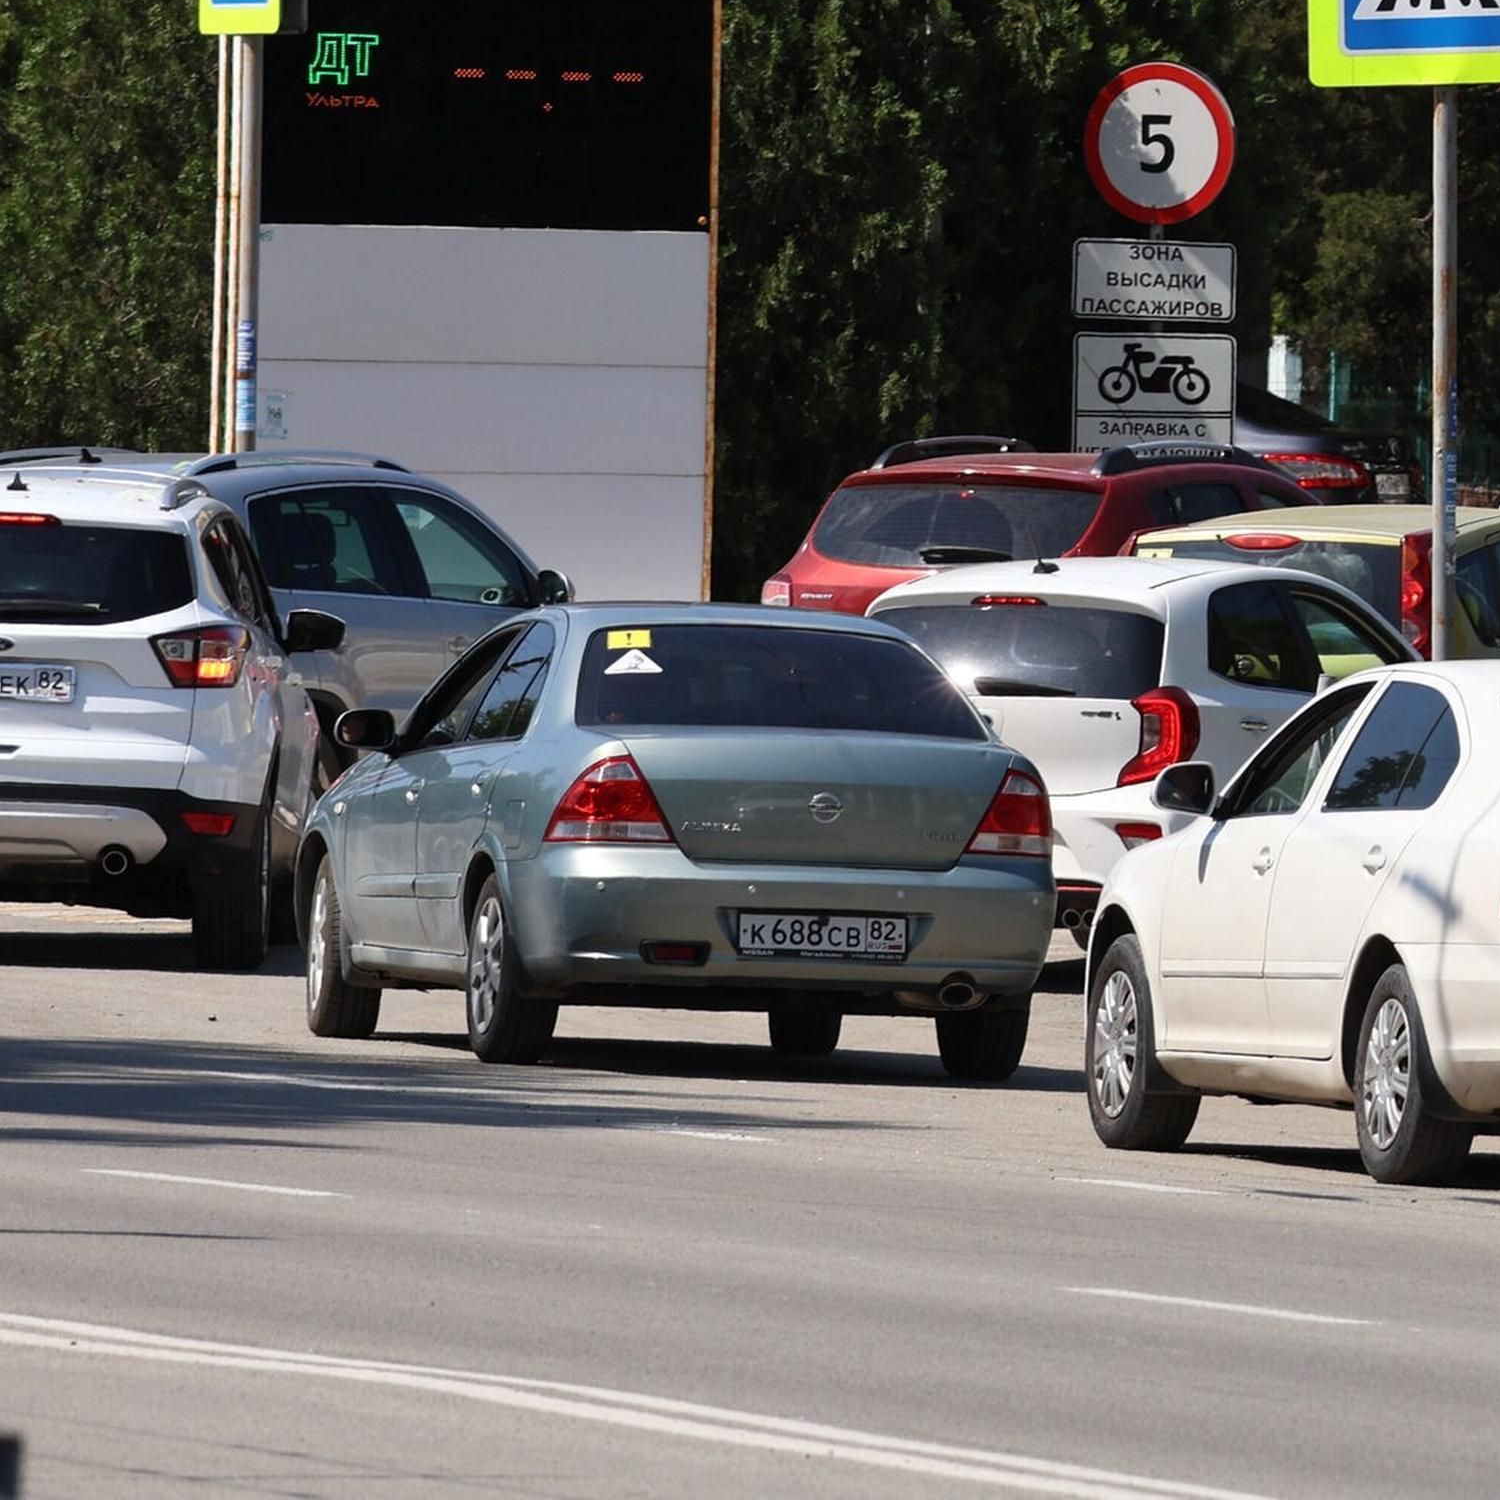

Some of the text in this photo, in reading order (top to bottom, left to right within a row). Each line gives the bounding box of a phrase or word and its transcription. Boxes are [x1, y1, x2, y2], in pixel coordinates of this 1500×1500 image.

[308, 33, 380, 85] ДТ
[1139, 114, 1175, 174] 5
[1129, 245, 1184, 262] ЗОНА
[1106, 272, 1206, 290] ВЫСАДКИ
[1081, 298, 1223, 318] ПАССАЖИРОВ
[1099, 421, 1207, 437] ЗАПРАВКА С
[38, 671, 64, 690] 82
[751, 918, 896, 948] К688СВ 82
